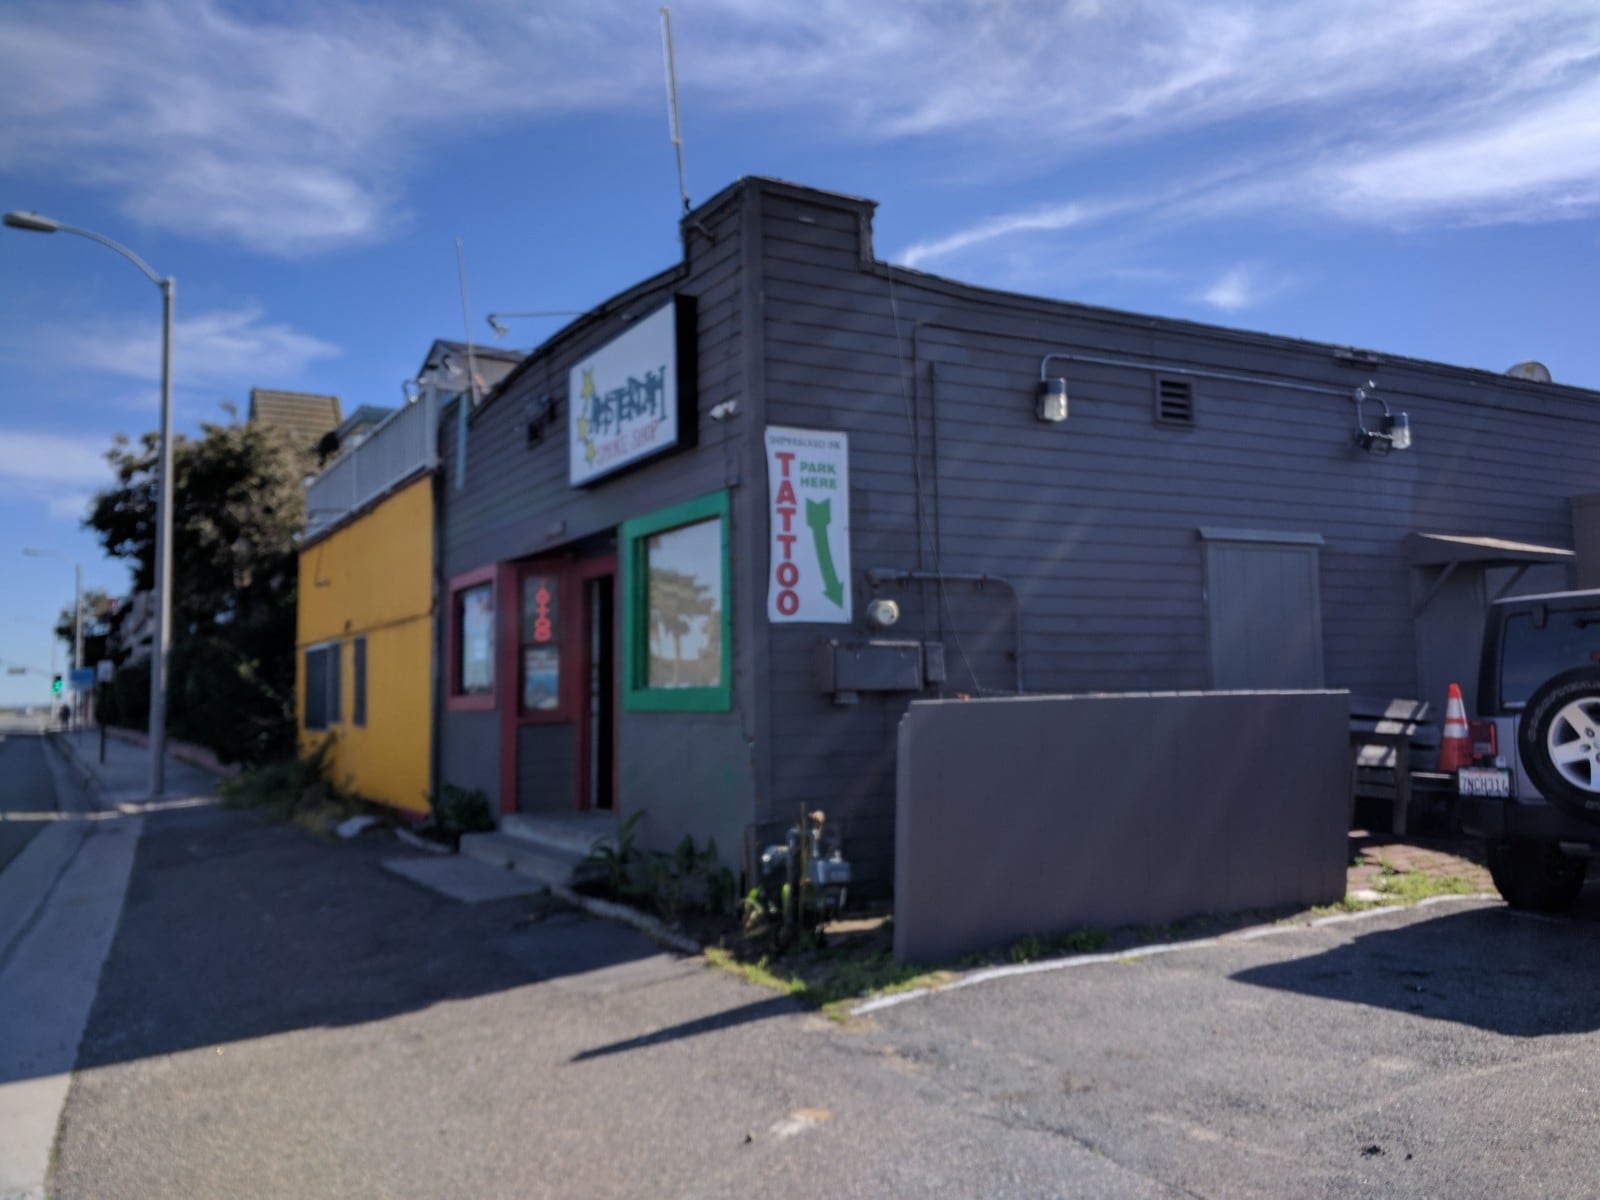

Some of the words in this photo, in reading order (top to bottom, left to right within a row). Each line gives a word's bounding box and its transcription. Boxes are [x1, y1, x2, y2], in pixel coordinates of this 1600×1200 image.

[632, 418, 660, 447] SHOP
[800, 461, 837, 474] PARK
[800, 477, 837, 489] HERE
[775, 452, 800, 616] TATTOO
